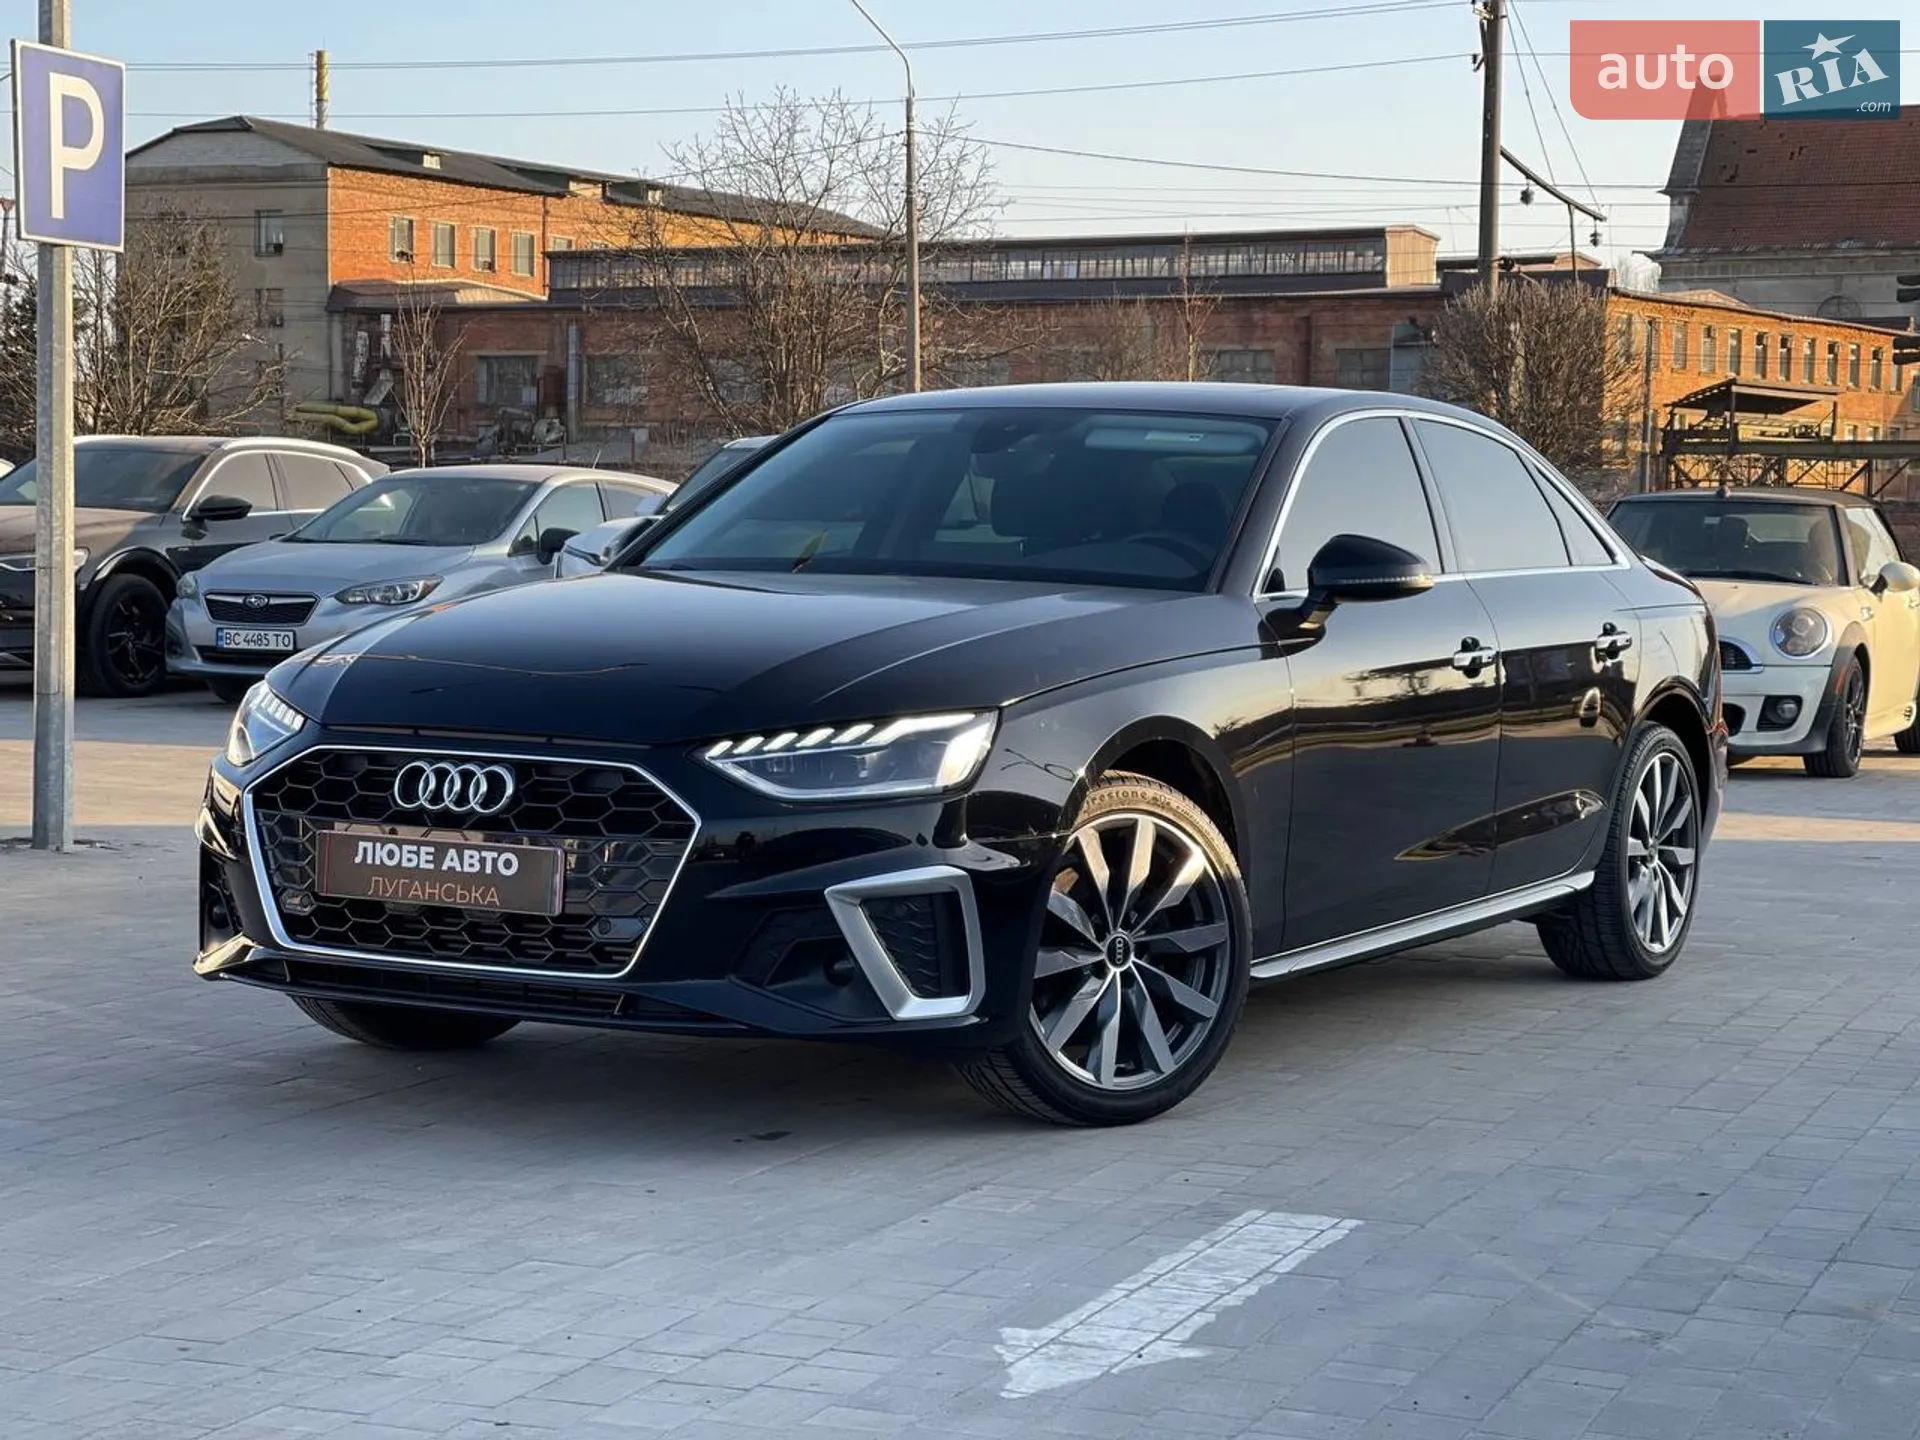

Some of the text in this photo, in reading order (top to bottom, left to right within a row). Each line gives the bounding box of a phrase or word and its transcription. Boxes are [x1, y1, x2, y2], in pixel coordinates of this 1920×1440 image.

[49, 72, 105, 220] P
[225, 631, 292, 648] BC 4485 TO
[1082, 790, 1147, 808] irestone
[354, 841, 519, 877] ЛЮБЕ АВТО
[367, 876, 500, 906] ЛУГАНСЬКА
